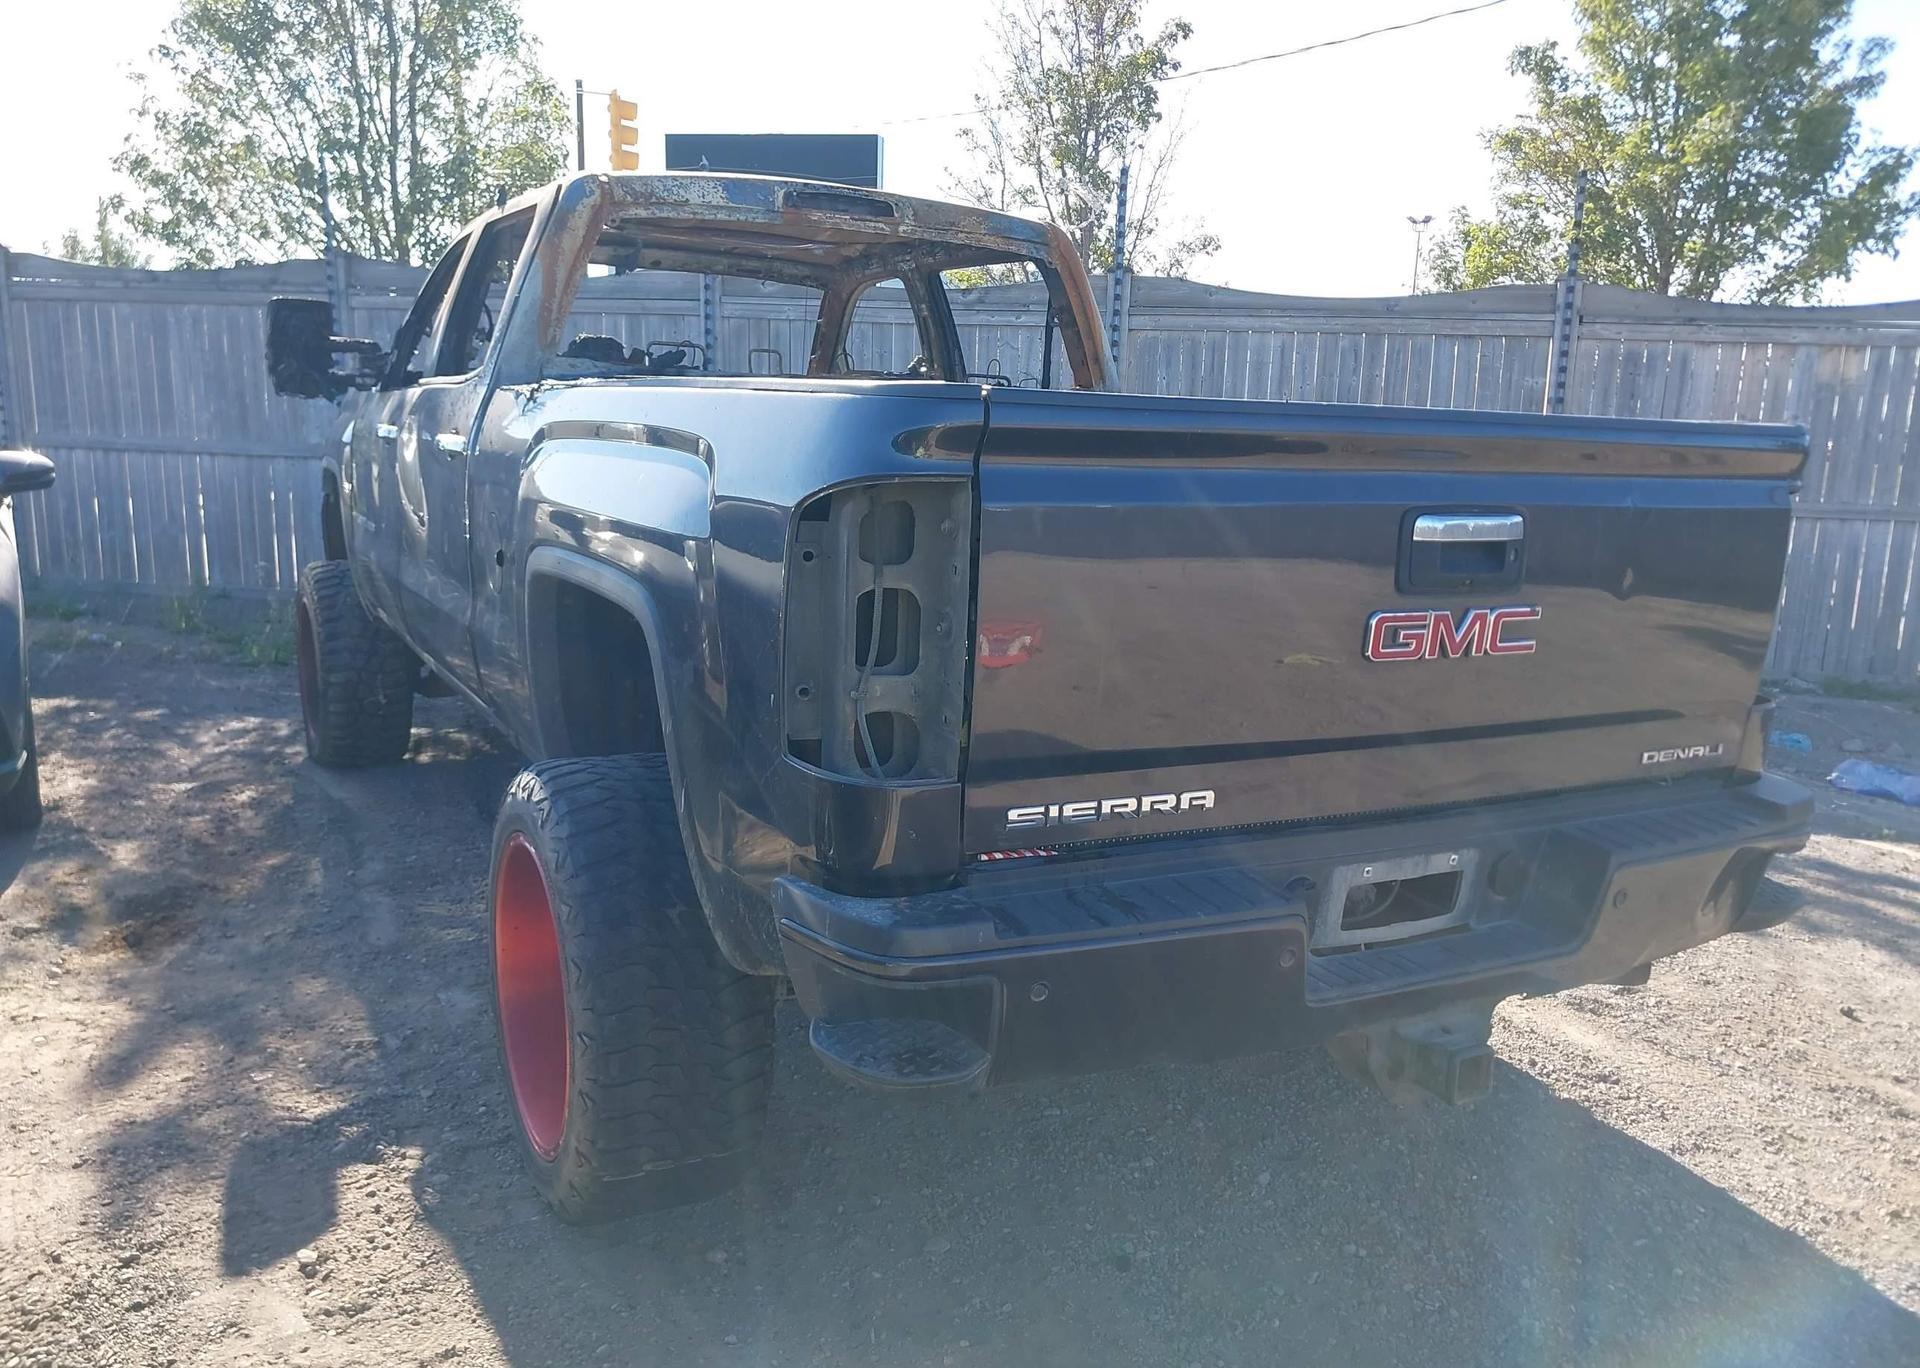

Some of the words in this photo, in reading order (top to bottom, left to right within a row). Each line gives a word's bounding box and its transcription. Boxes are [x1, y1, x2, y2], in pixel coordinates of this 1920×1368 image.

[1365, 607, 1542, 662] GMC
[1641, 743, 1724, 764] DENALI
[1005, 789, 1216, 831] SIERRA
